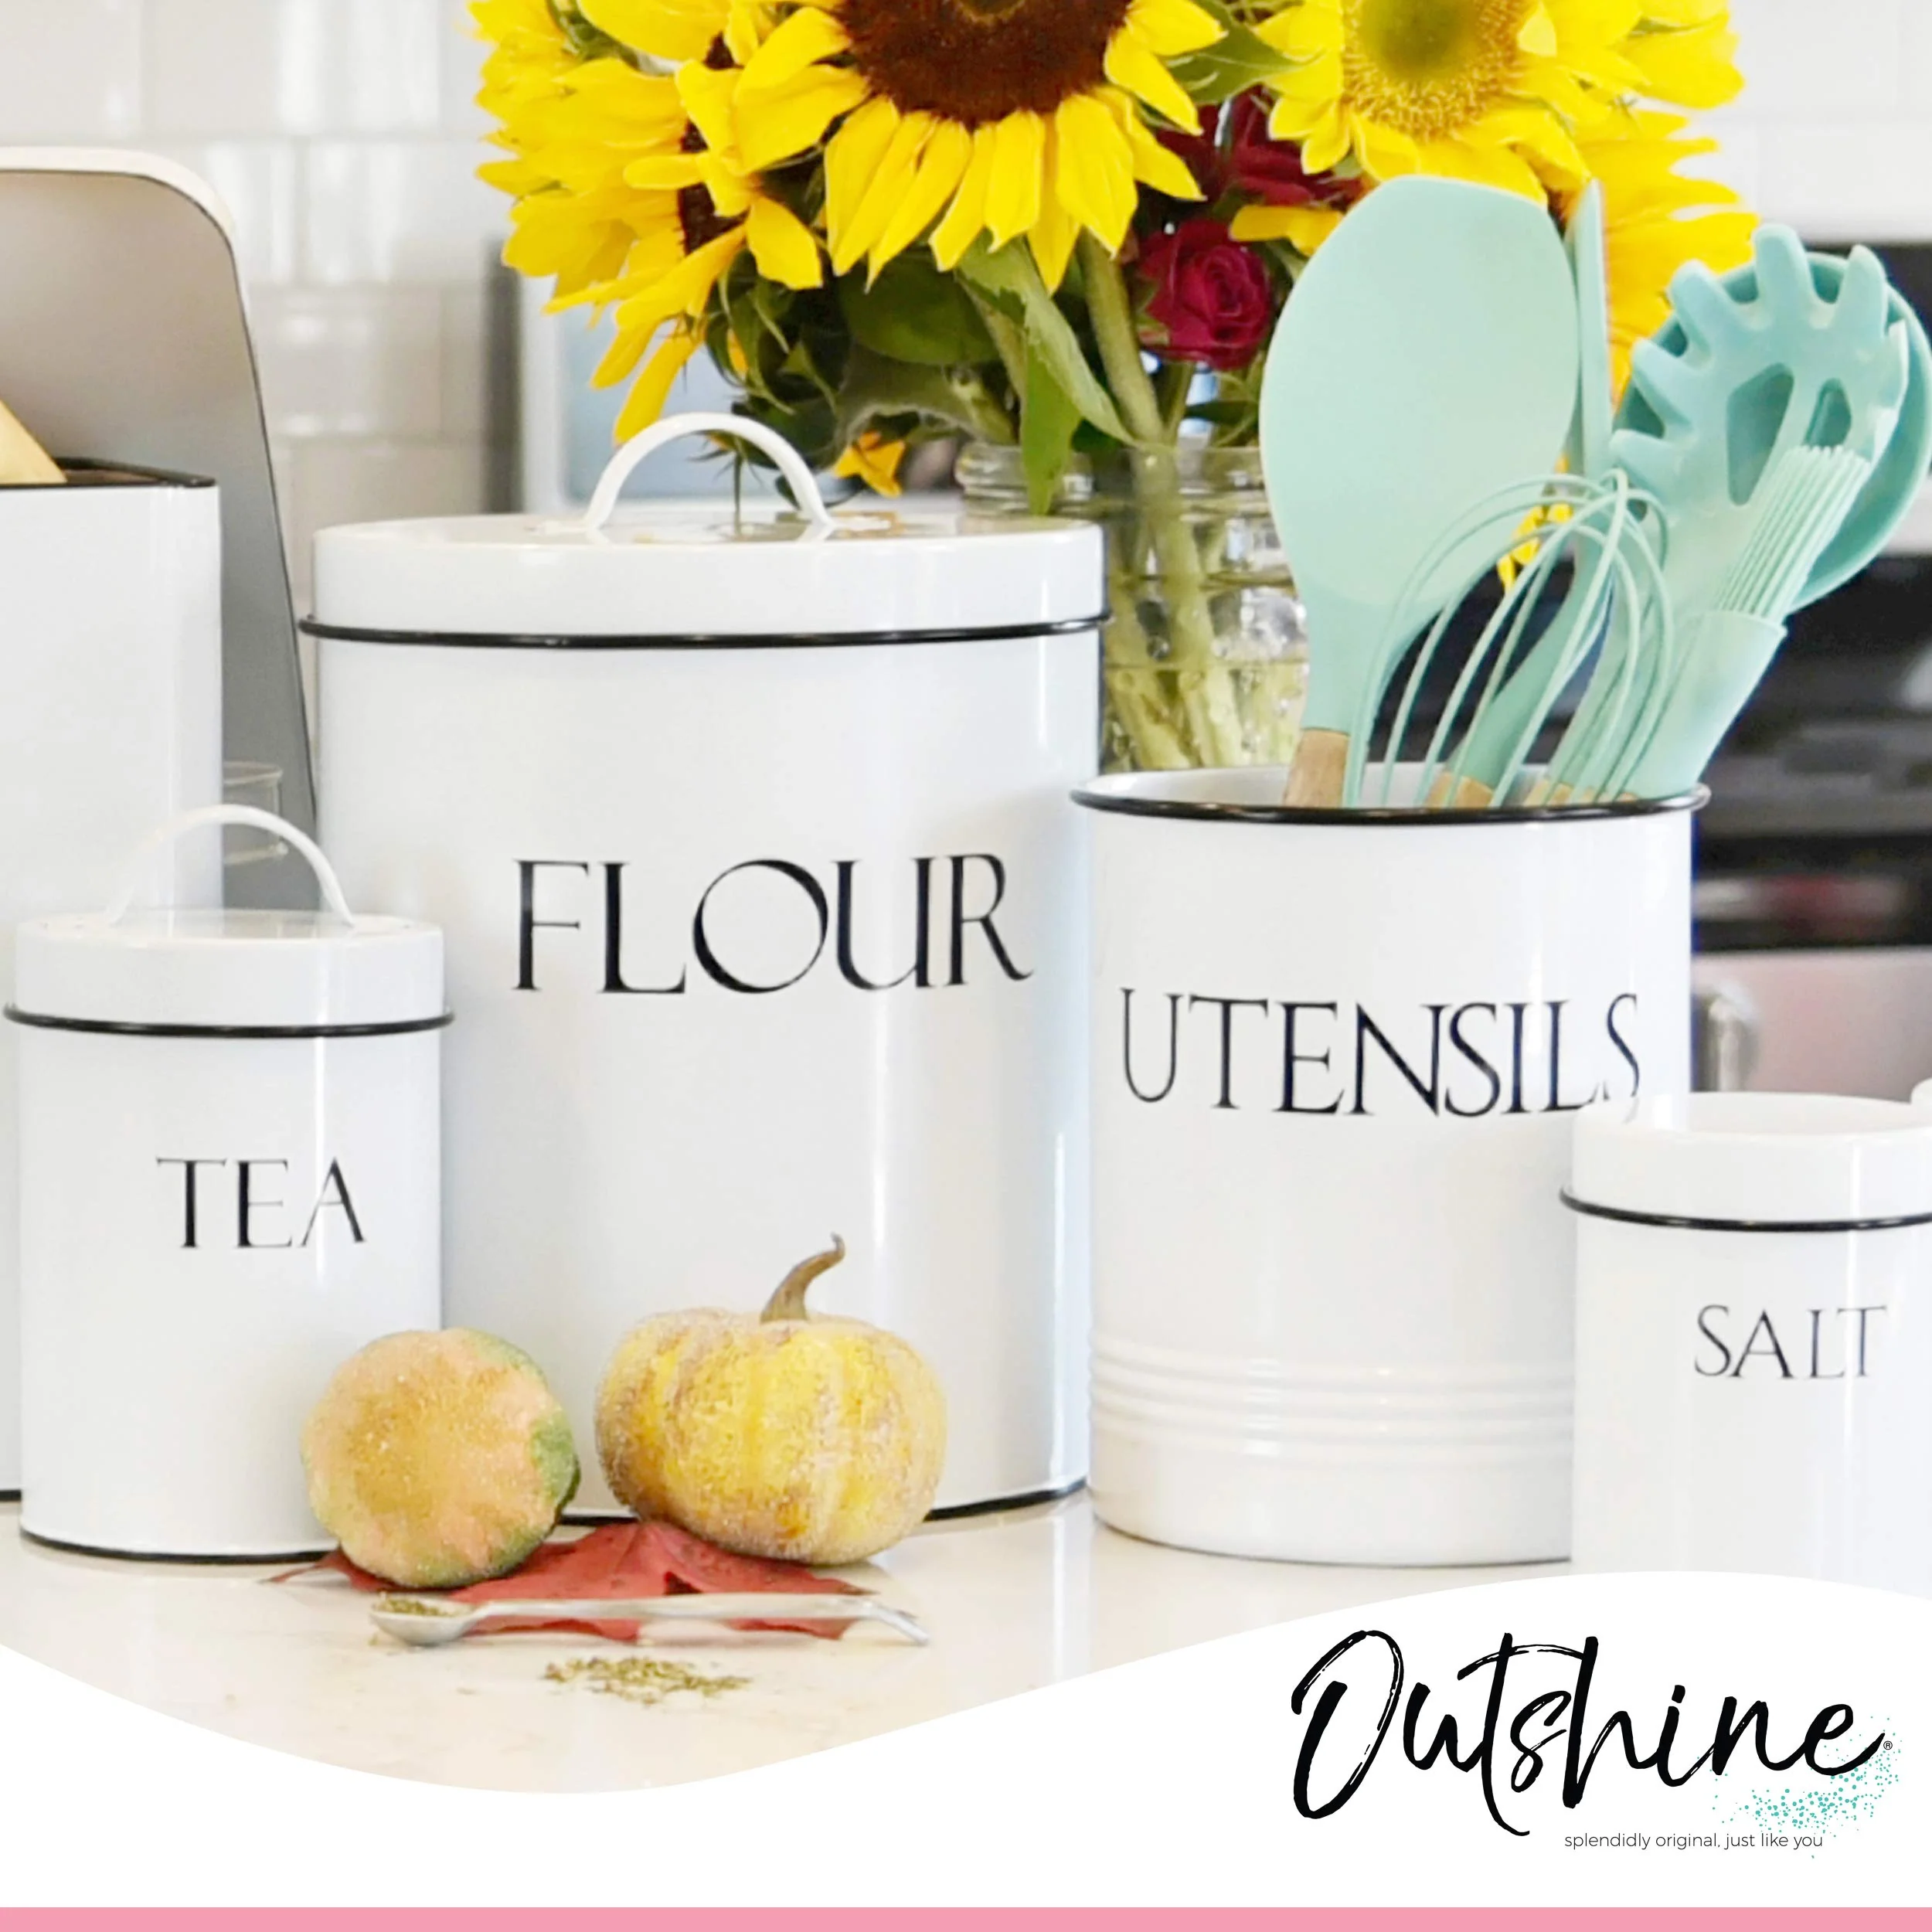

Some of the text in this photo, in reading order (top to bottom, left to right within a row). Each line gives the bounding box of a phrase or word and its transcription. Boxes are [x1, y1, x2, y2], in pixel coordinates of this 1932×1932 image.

[515, 853, 1032, 995] FLOUR
[1120, 988, 1640, 1117] UTENSILS
[157, 1158, 365, 1249] TEA
[1694, 1304, 1887, 1379] SALT
